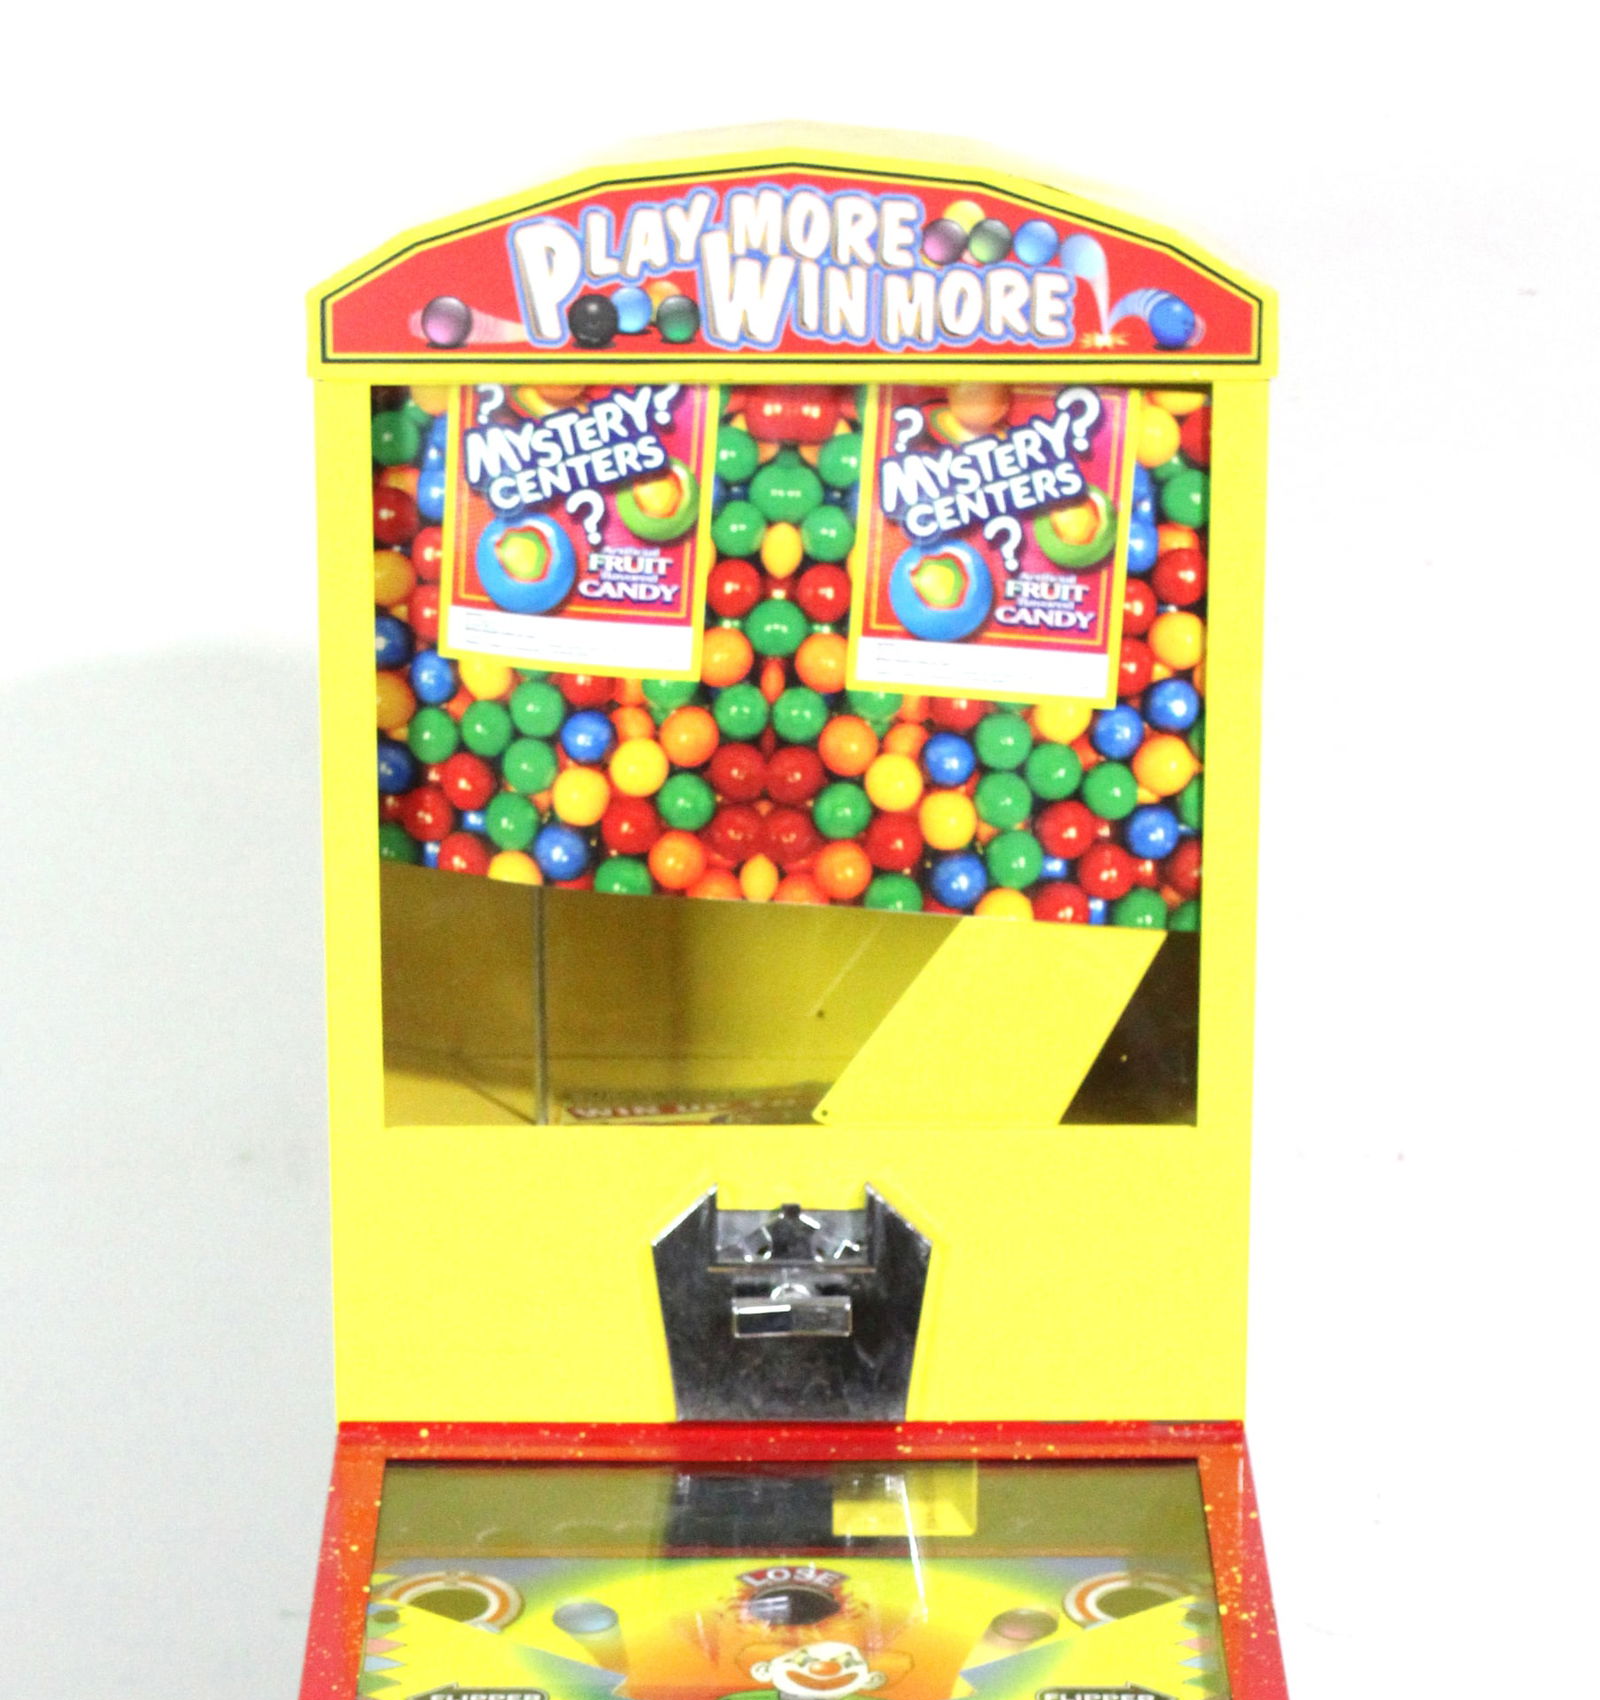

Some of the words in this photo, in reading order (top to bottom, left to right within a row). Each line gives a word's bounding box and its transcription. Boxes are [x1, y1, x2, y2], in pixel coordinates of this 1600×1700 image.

[511, 189, 713, 342] PLAY
[729, 188, 920, 268] MORE
[882, 266, 1071, 346] MORE
[489, 435, 665, 510] CENTERS
[905, 462, 1083, 537] CENTERS
[588, 552, 674, 576] FRUIT
[577, 579, 681, 603] CANDY
[1005, 579, 1091, 604] FRUIT
[994, 605, 1097, 631] CANDY
[741, 1567, 841, 1588] LOSE
